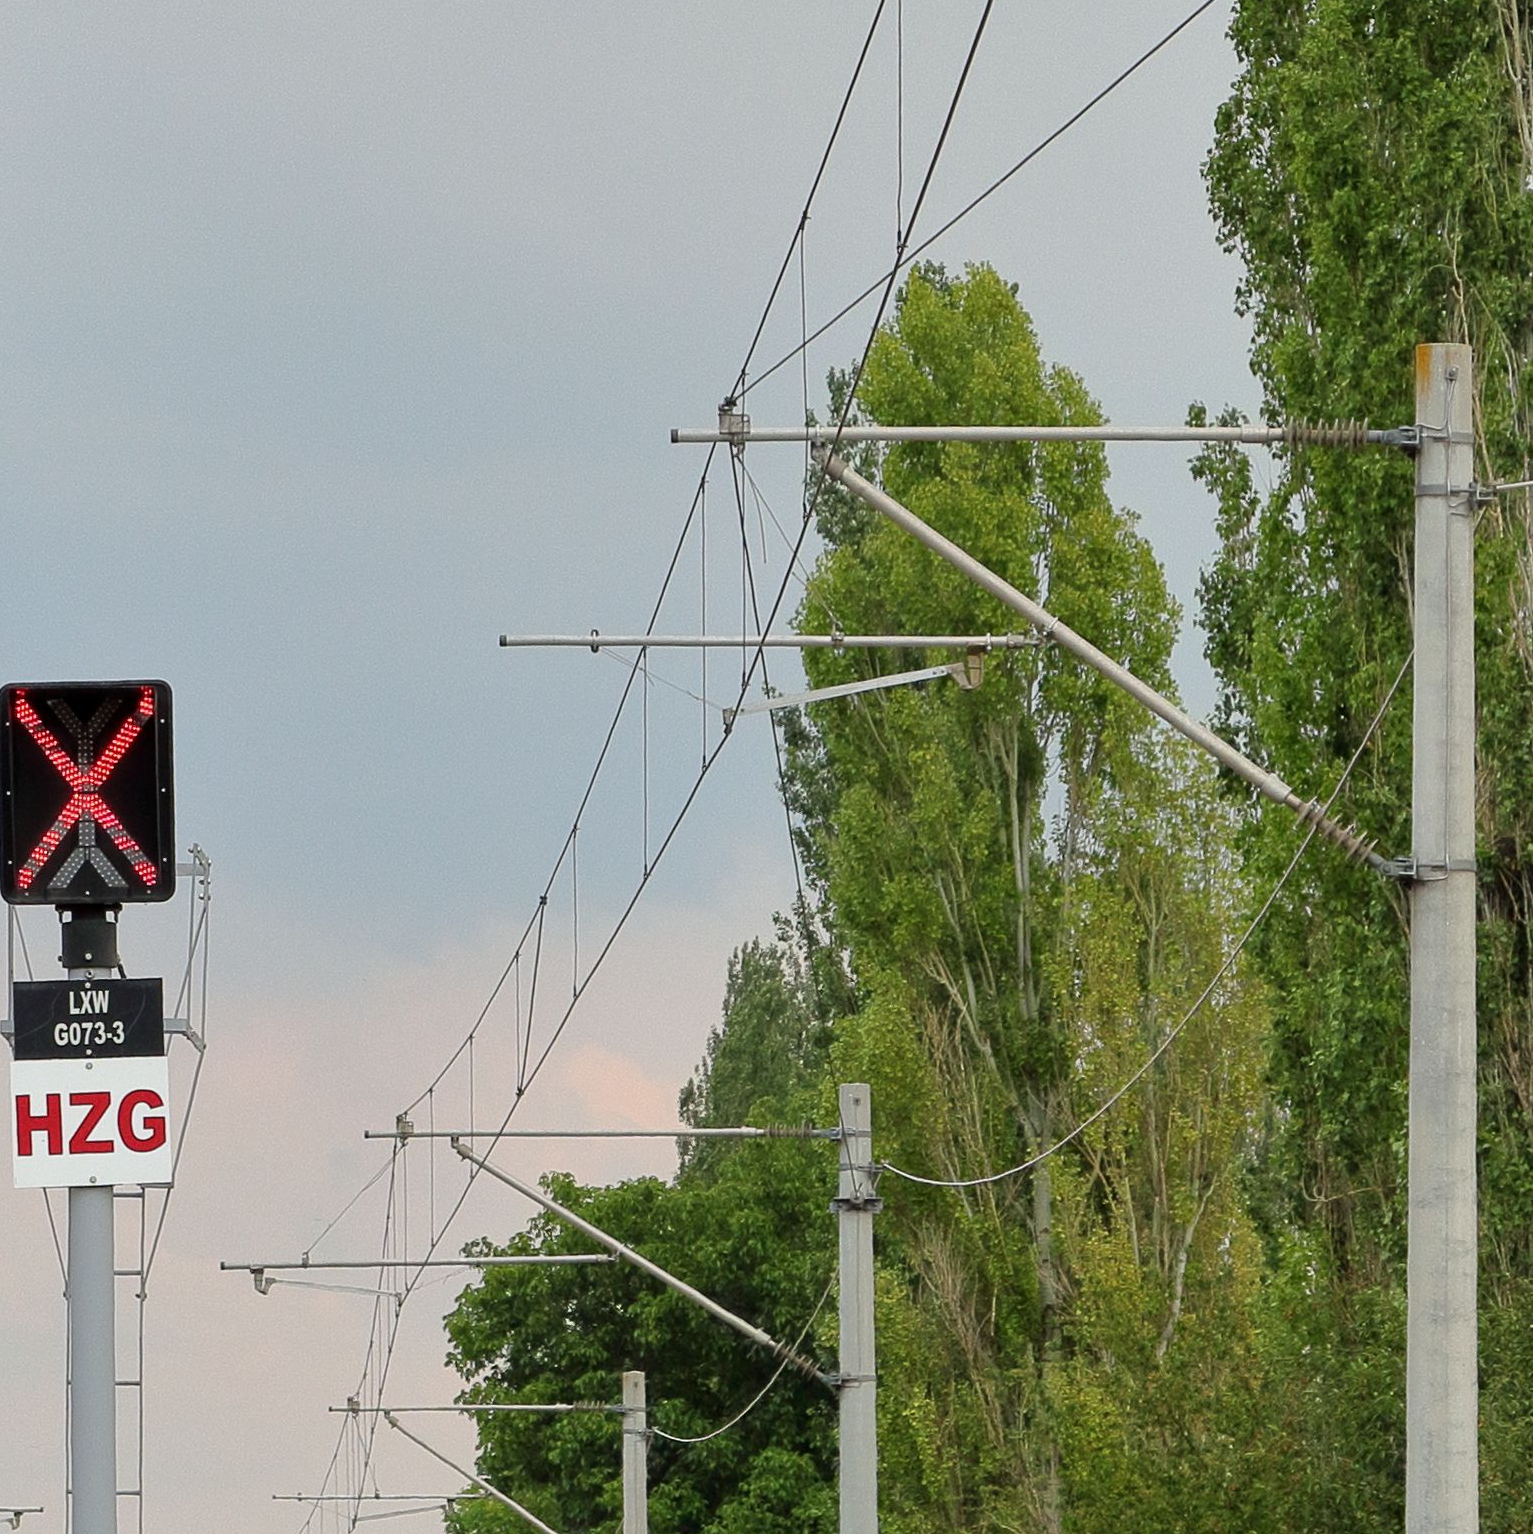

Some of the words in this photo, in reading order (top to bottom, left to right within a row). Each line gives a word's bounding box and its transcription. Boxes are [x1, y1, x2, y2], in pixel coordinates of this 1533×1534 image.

[68, 990, 110, 1015] LXW
[53, 1021, 126, 1047] G073-3
[15, 1088, 167, 1157] HZG
